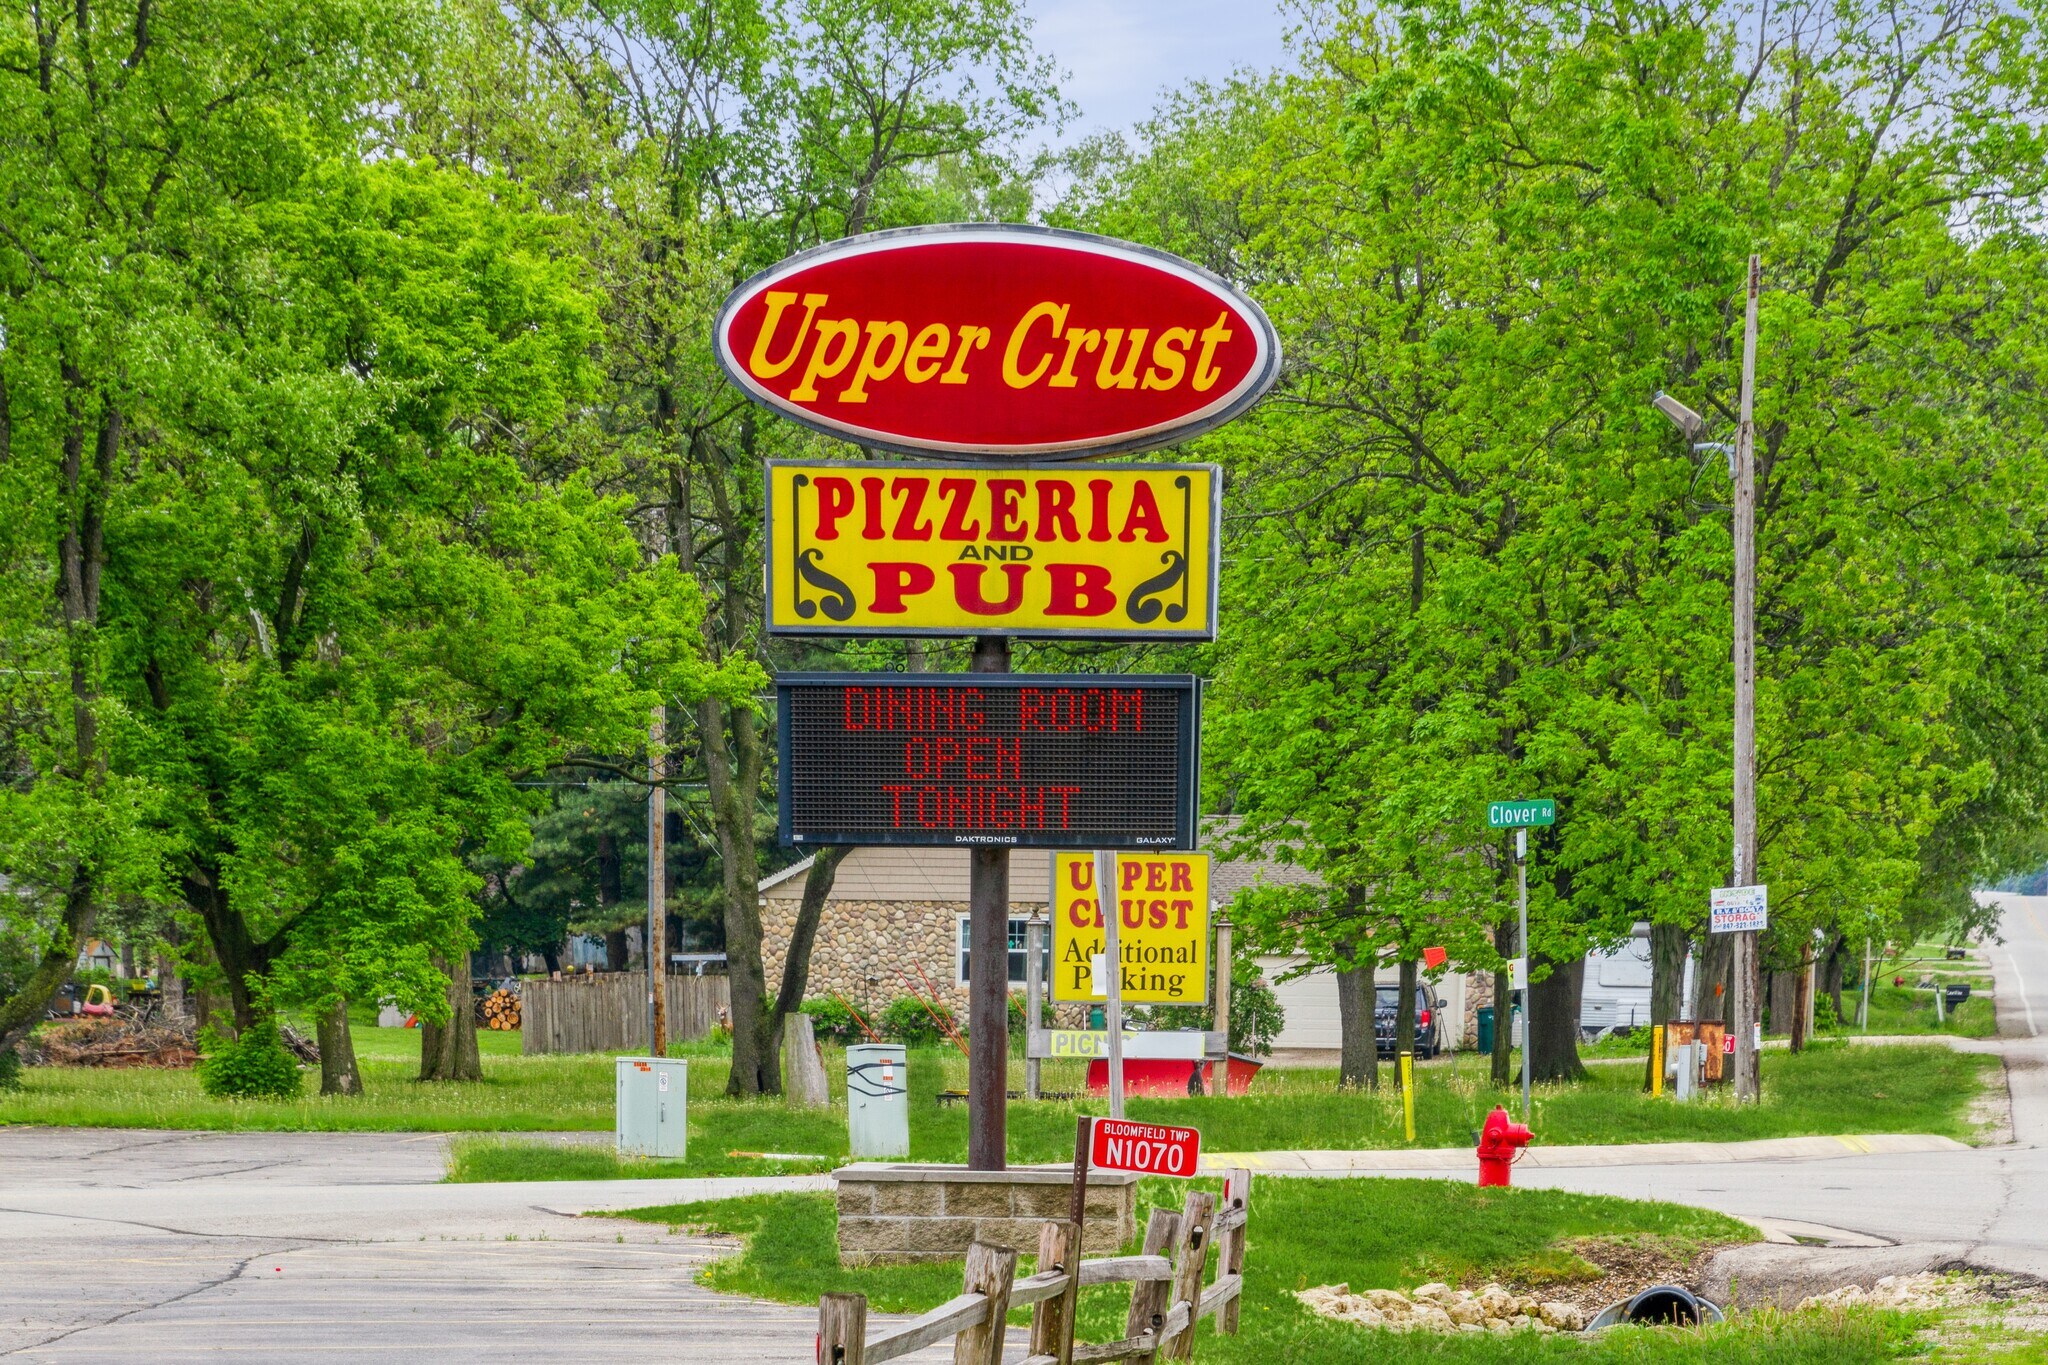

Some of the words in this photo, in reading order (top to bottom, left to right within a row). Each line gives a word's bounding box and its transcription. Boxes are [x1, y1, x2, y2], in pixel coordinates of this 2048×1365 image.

[749, 291, 991, 403] Upper
[1002, 301, 1232, 391] Crust
[813, 476, 1170, 543] PIZZERIA
[957, 545, 1034, 561] AND
[867, 562, 1118, 616] PUB
[845, 687, 984, 731] DINING
[1020, 687, 1143, 731] ROOM
[905, 737, 1021, 780] OPEN
[882, 785, 1081, 829] TONIGHT
[1490, 805, 1537, 825] Clover
[1542, 807, 1552, 818] Rd
[955, 835, 1018, 843] DAKTRONICS
[1069, 861, 1194, 892] UPER
[1714, 912, 1762, 924] STORAG
[1063, 937, 1197, 964] Aditional
[1073, 965, 1186, 997] Pking
[1104, 1122, 1166, 1140] BLOOMFIELD
[1170, 1129, 1190, 1142] TWP
[1106, 1137, 1184, 1173] N1070
